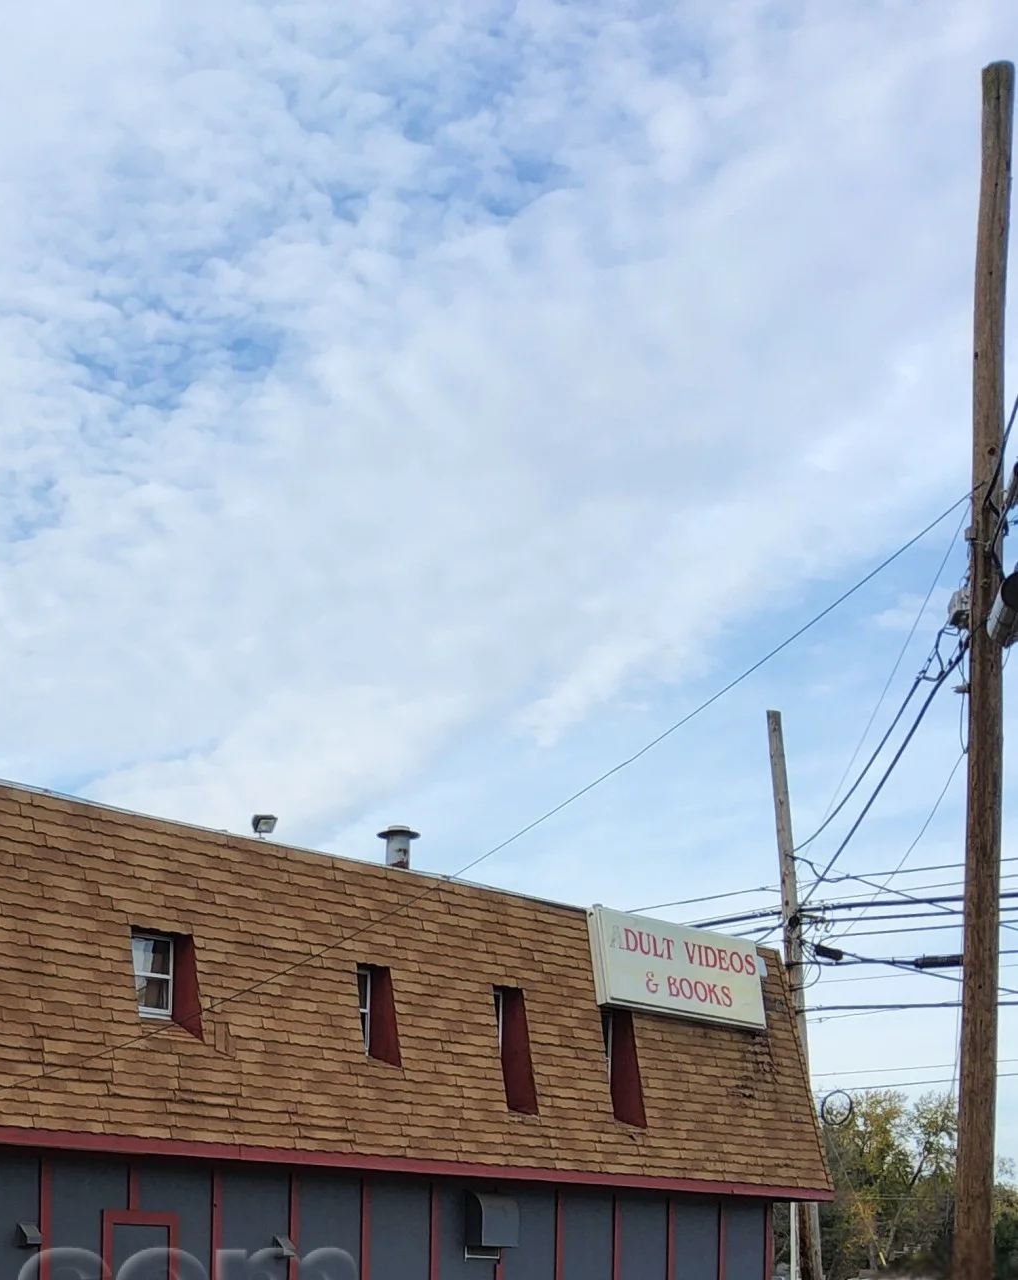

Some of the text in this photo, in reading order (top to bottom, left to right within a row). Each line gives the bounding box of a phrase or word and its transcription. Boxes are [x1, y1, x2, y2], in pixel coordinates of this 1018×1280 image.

[684, 941, 756, 975] VIDEOS
[646, 971, 733, 1007] & BOOKS
